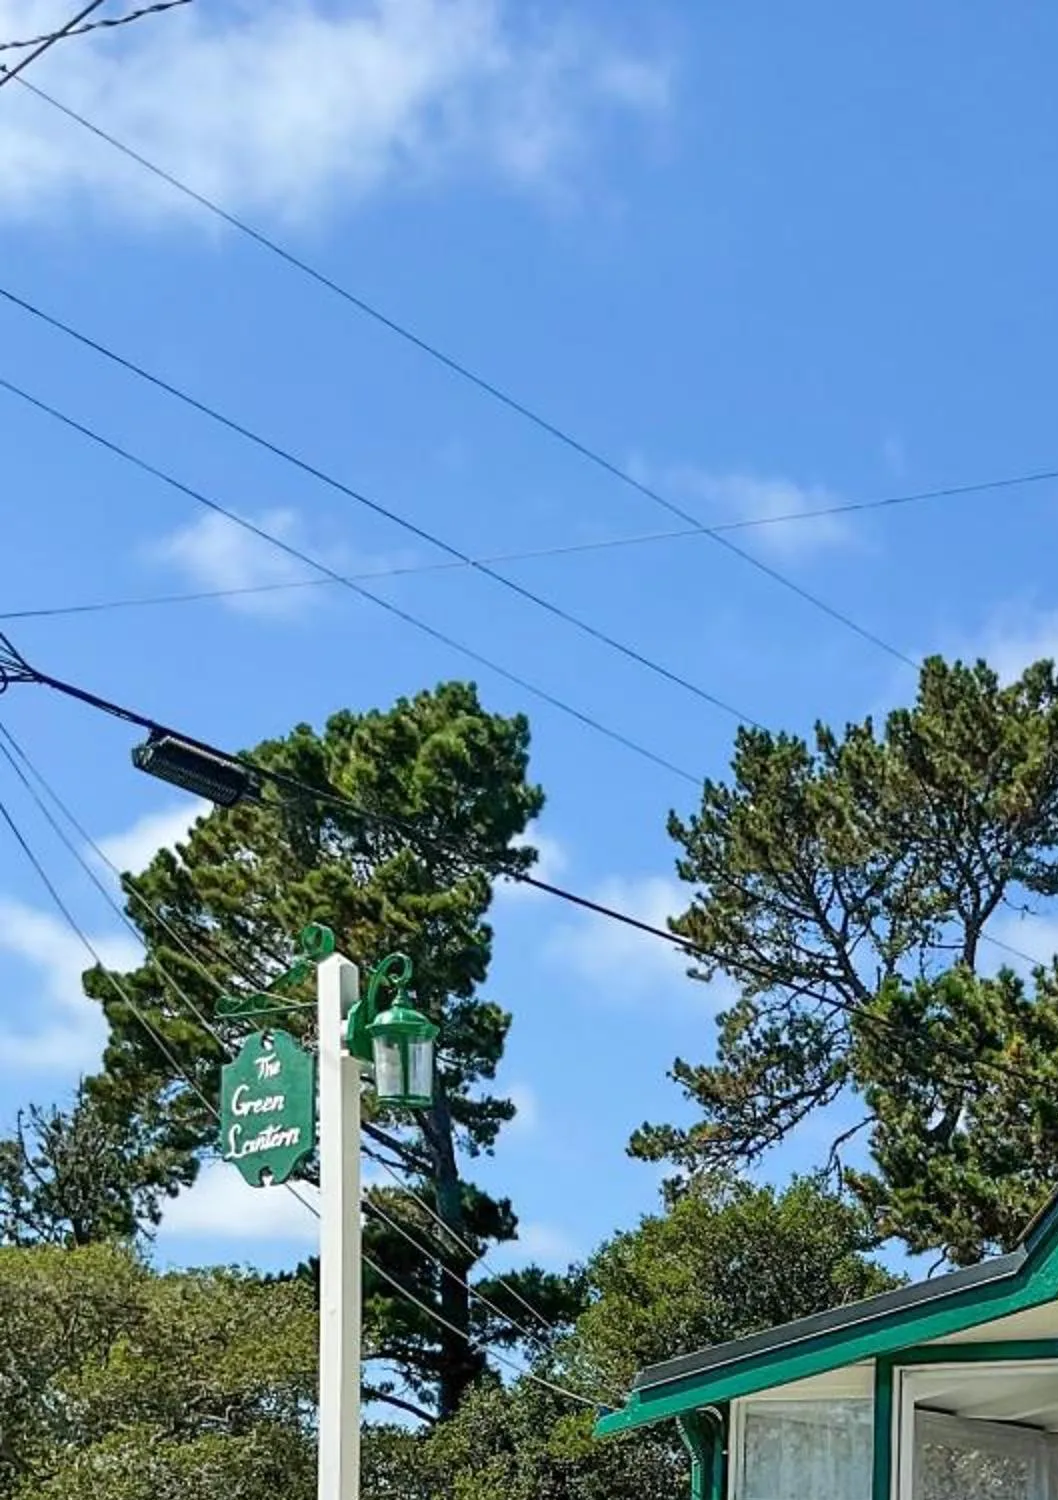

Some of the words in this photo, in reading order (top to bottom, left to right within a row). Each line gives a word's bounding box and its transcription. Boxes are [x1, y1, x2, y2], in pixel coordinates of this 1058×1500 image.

[255, 1052, 281, 1080] The
[231, 1085, 285, 1115] Green
[224, 1124, 301, 1159] Lantern
